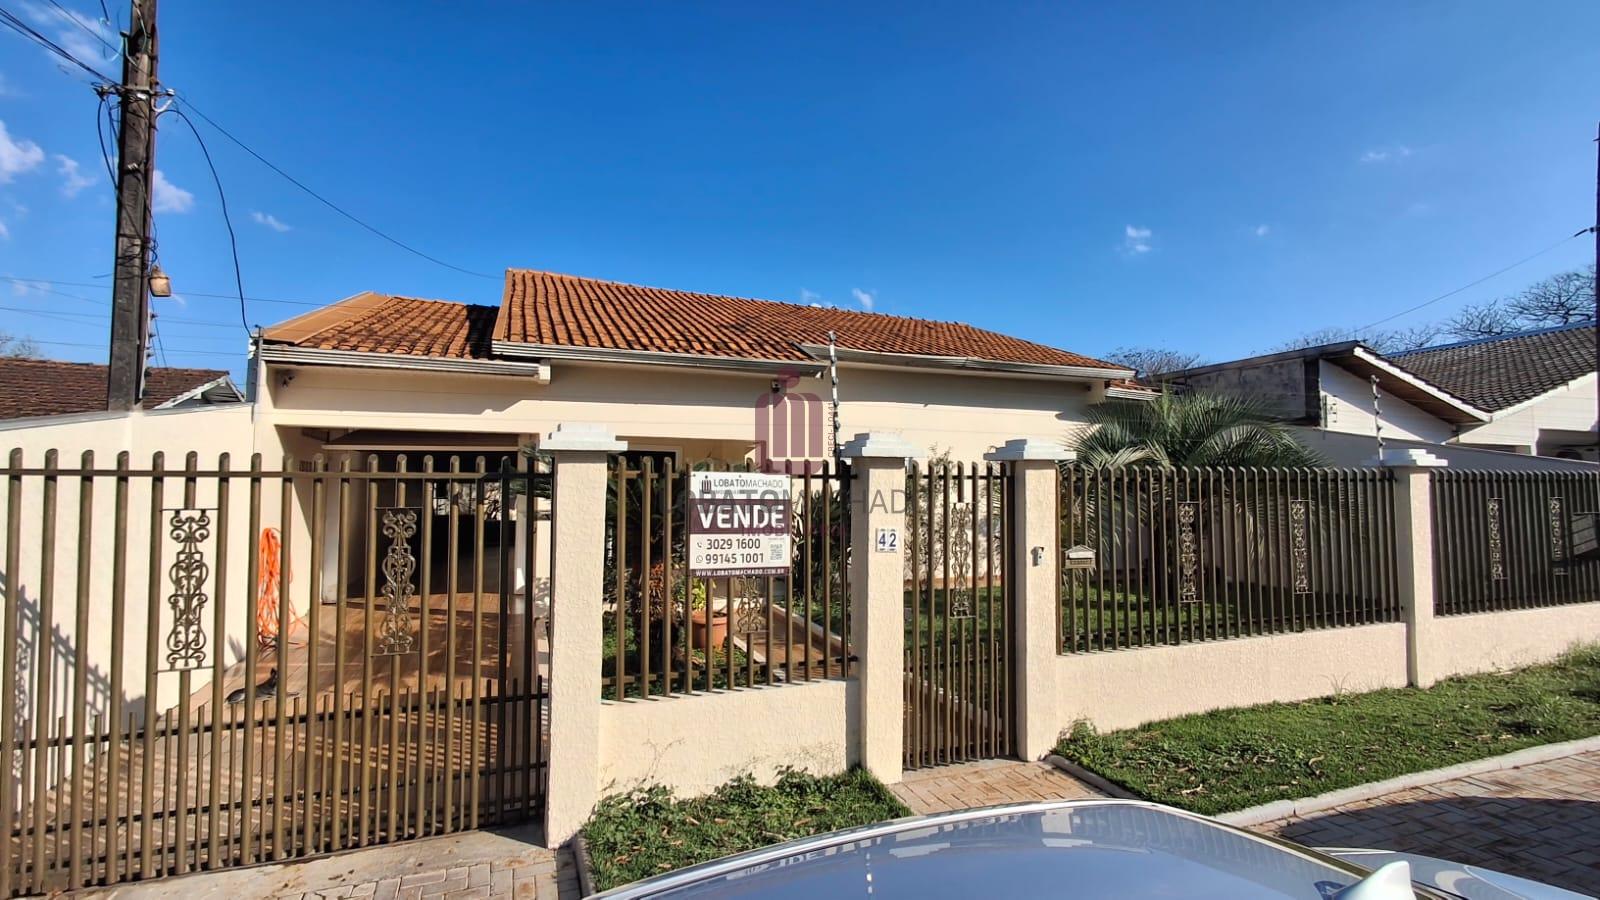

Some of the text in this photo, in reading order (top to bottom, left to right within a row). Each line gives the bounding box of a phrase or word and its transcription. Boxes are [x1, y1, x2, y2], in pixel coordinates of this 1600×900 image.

[713, 478, 784, 489] LOBATOMACHADO
[697, 504, 786, 530] VENDE
[706, 538, 761, 550] 3029 1600
[878, 532, 897, 548] 42
[705, 552, 765, 565] 99145 1001
